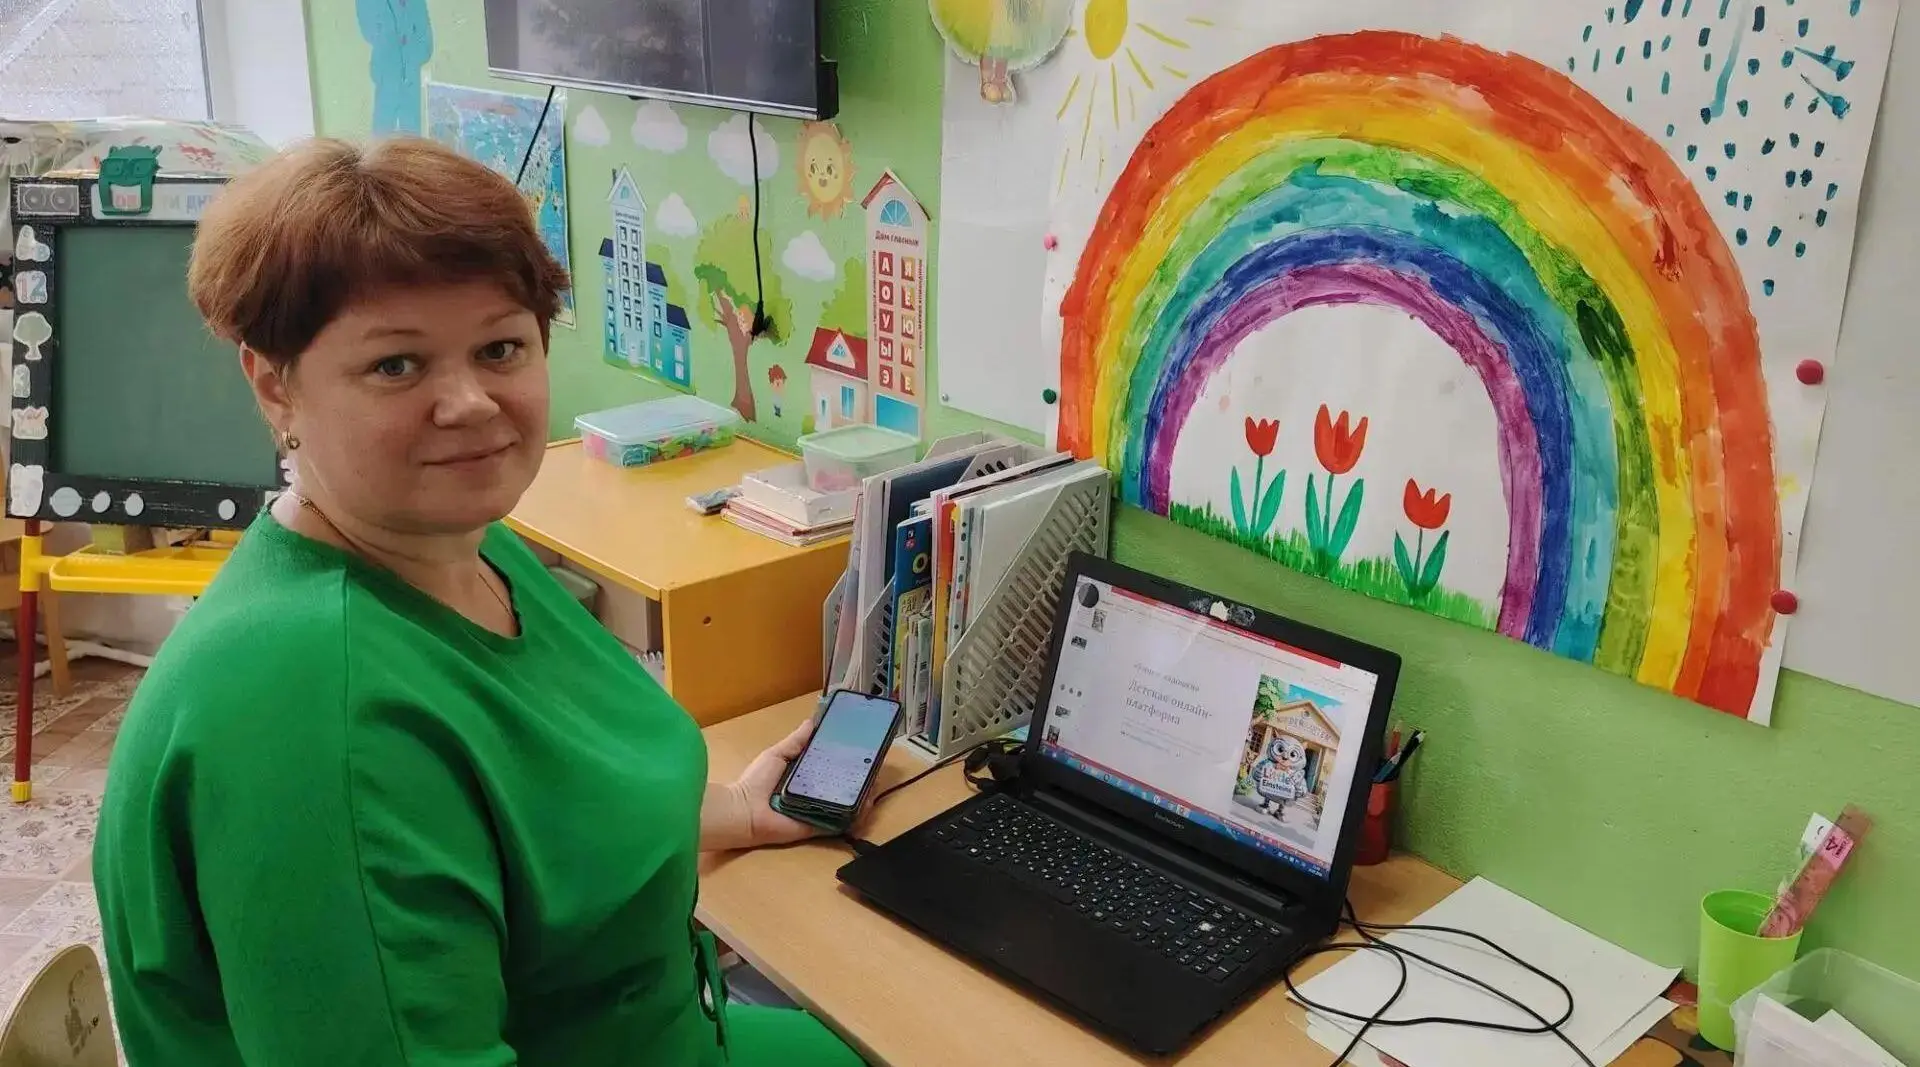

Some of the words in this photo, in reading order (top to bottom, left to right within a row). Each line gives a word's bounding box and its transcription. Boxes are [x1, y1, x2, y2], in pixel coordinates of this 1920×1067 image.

[881, 256, 891, 273] А
[881, 285, 891, 301] О
[882, 313, 891, 329] У
[902, 318, 914, 334] Ю
[880, 341, 892, 358] Ы
[882, 369, 890, 385] Э
[1127, 679, 1168, 703] Детская
[1125, 697, 1181, 725] платформа
